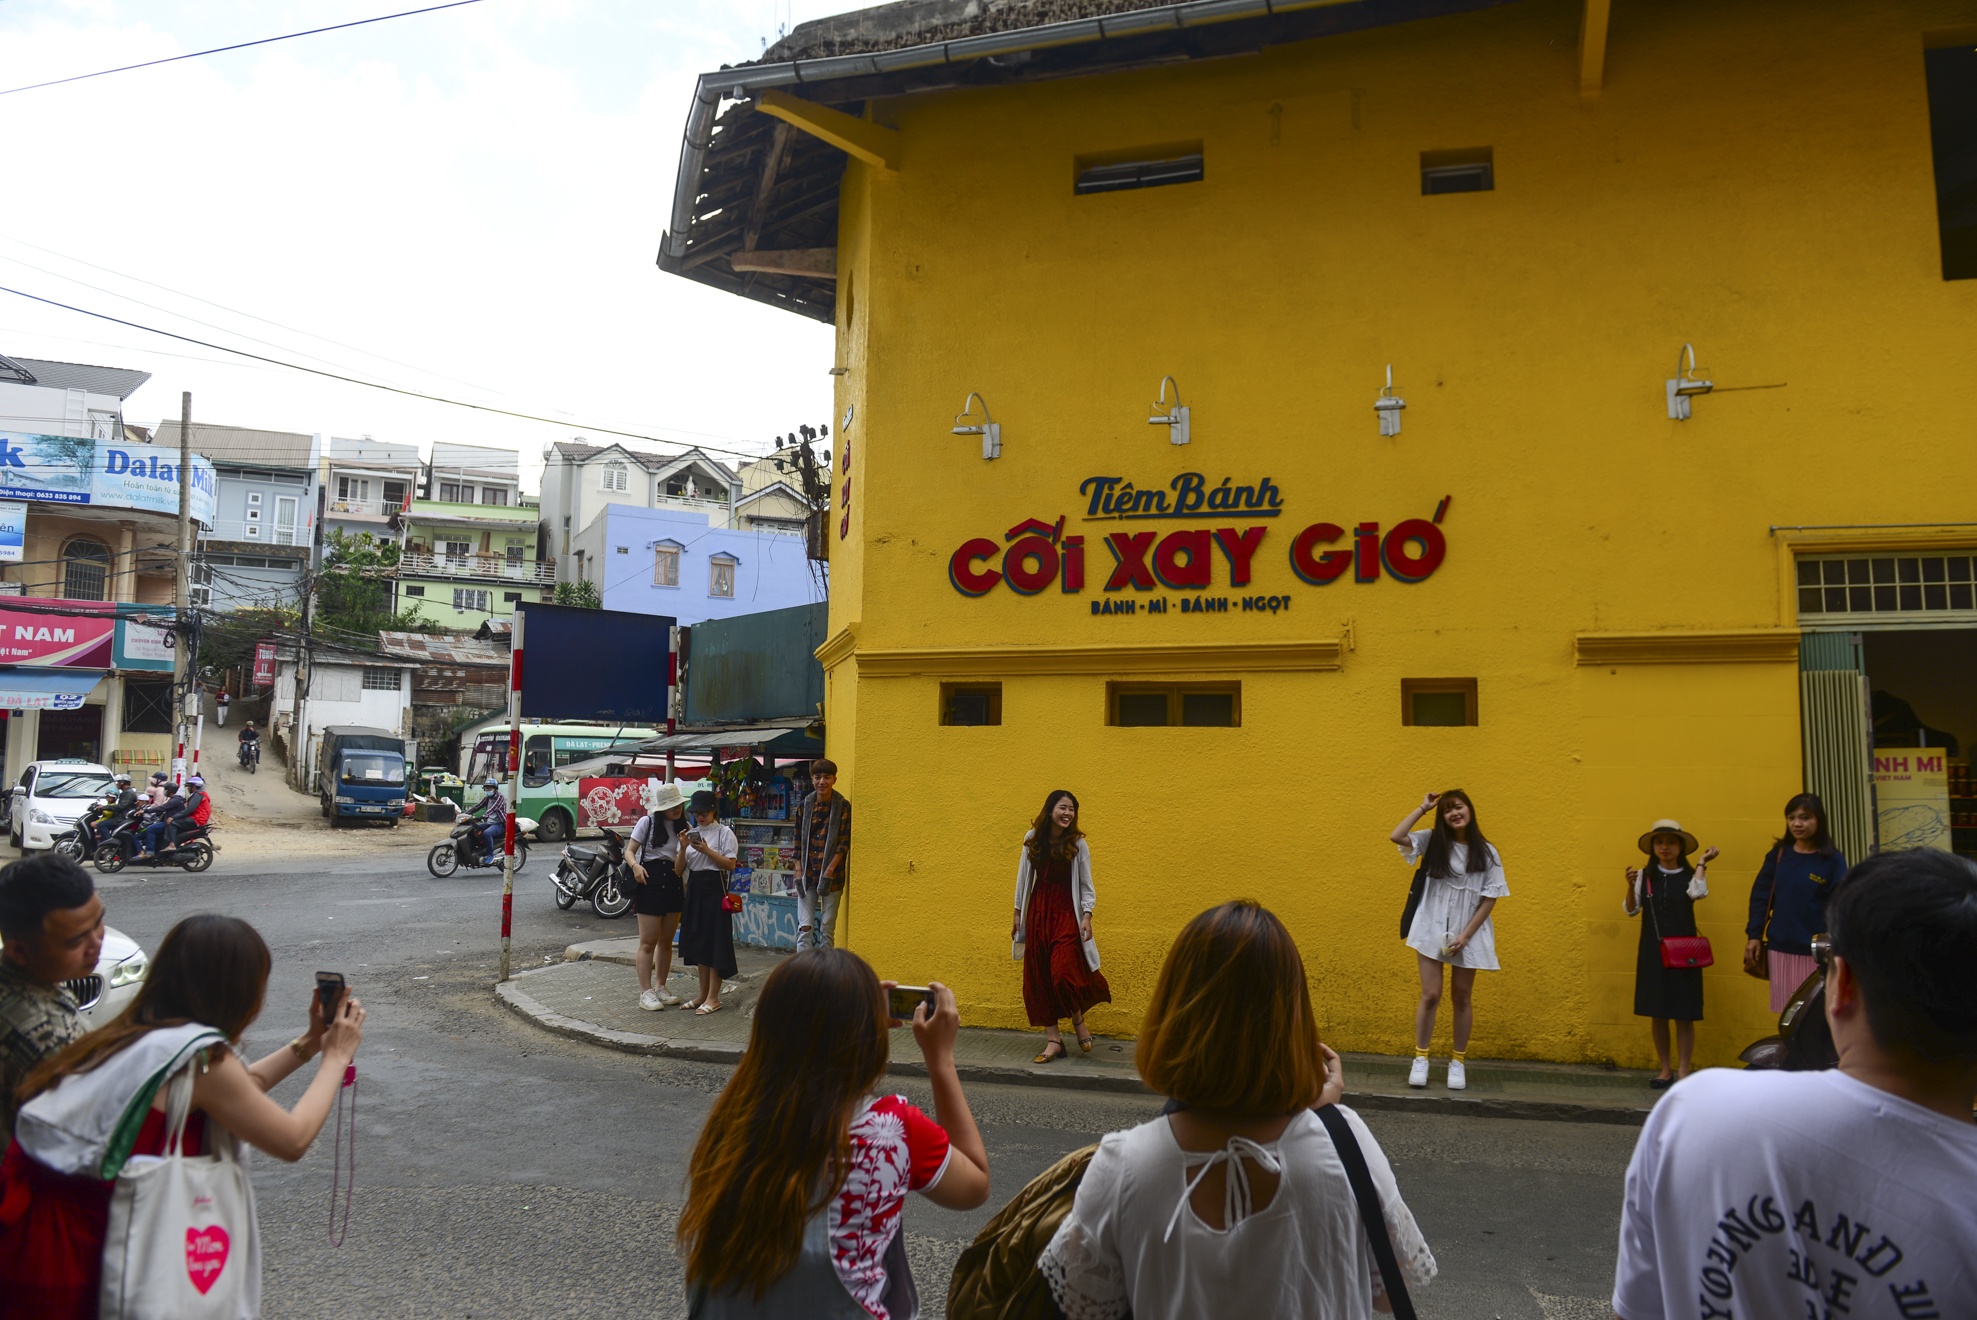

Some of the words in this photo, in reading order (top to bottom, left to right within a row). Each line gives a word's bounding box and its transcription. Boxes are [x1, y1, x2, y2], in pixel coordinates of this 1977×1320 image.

[1170, 472, 1284, 515] Bánh
[0, 523, 14, 533] ên
[1091, 597, 1136, 615] BÁNH
[1181, 595, 1228, 612] BÁNH
[1242, 595, 1291, 614] NGỌT
[15, 625, 75, 643] NAM
[1874, 756, 1909, 773] NH
[1916, 756, 1943, 773] MI
[1793, 1199, 1904, 1277] AND
